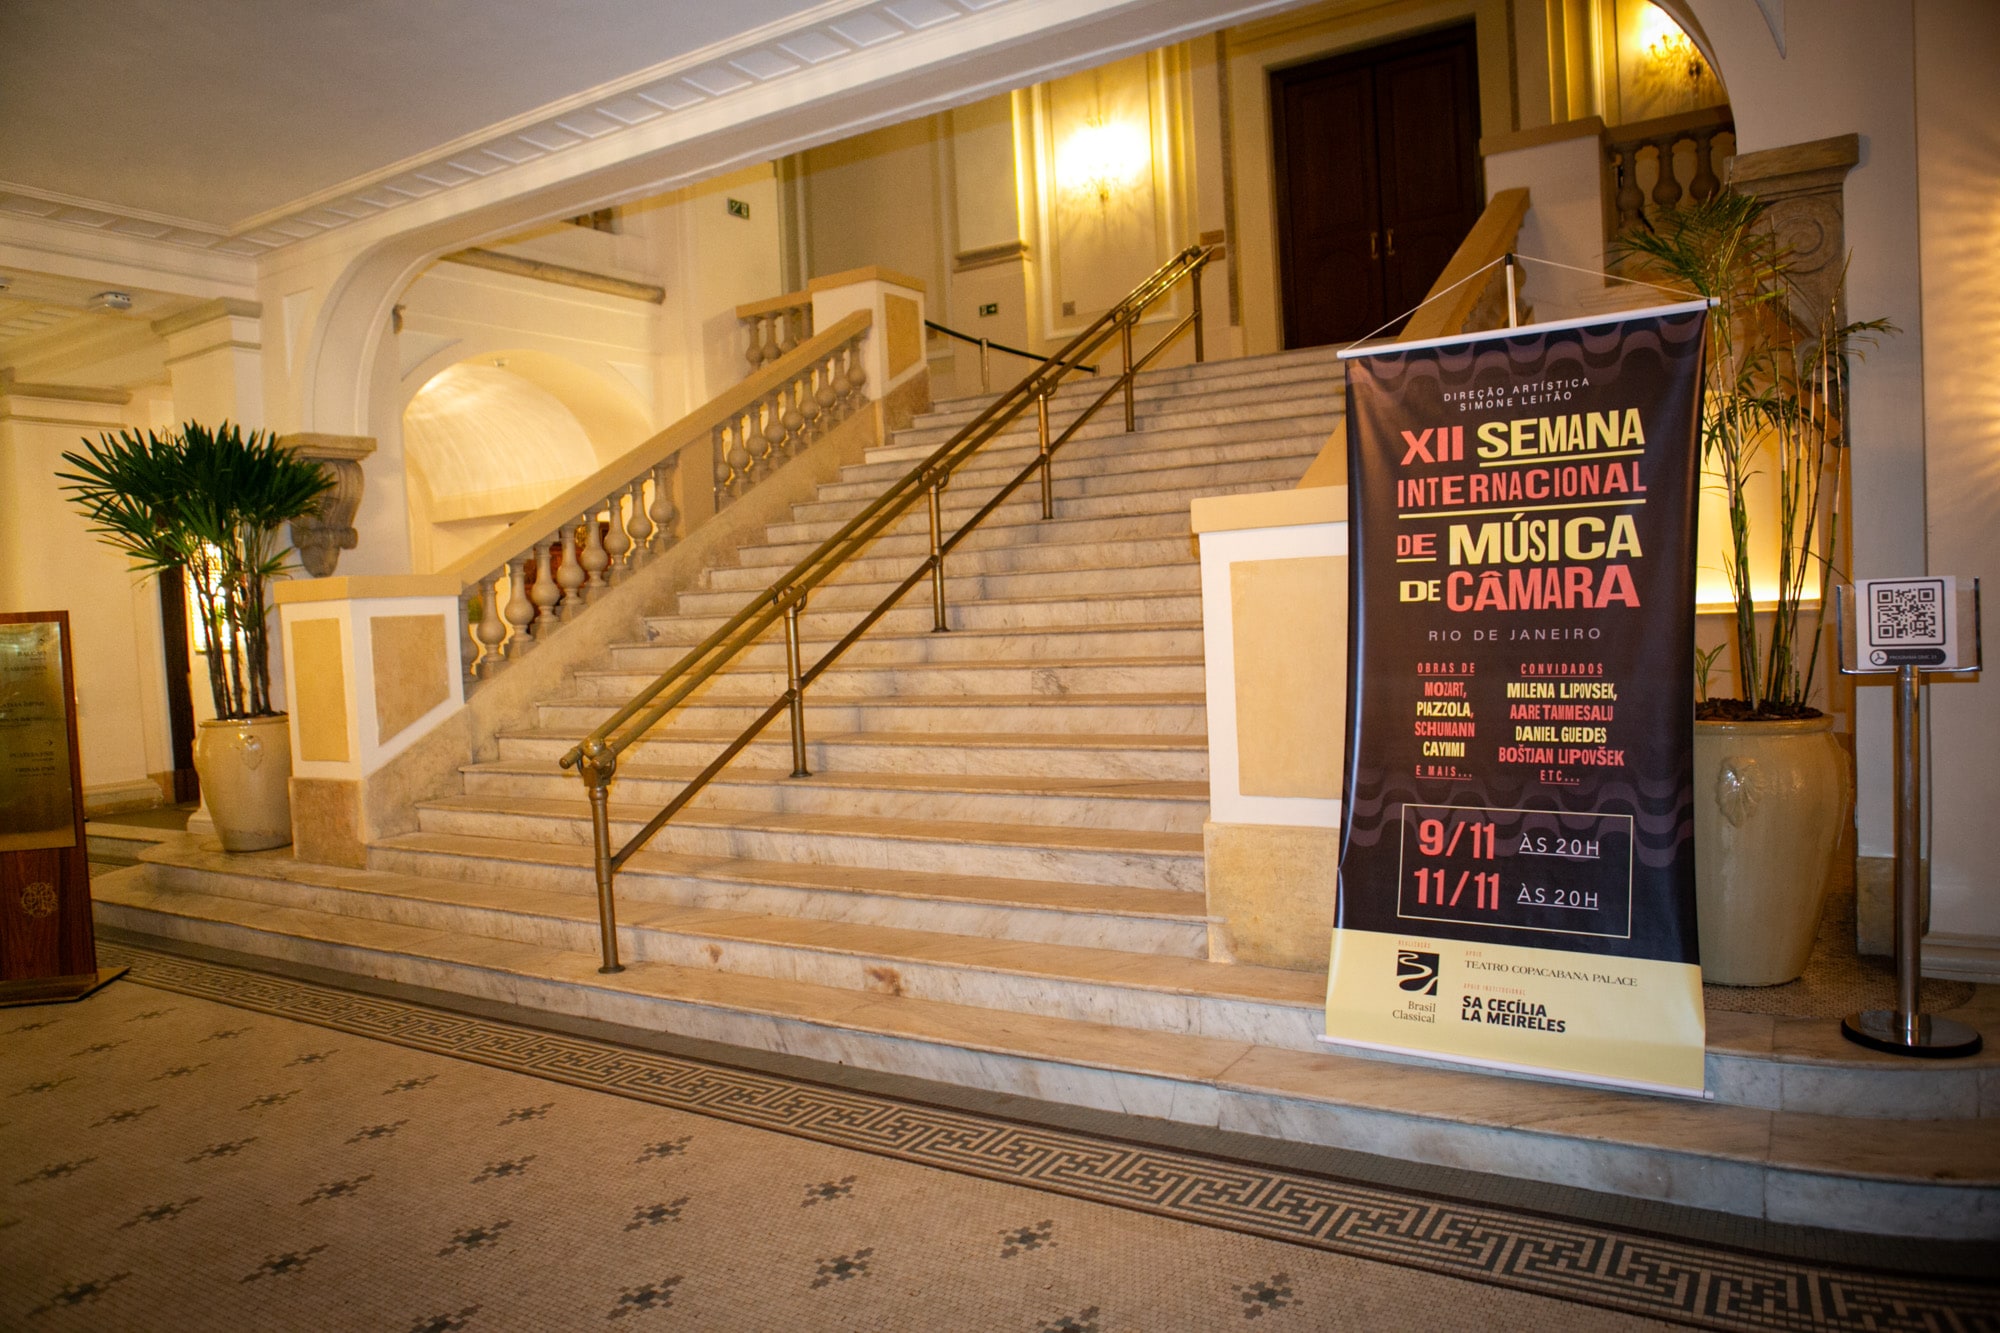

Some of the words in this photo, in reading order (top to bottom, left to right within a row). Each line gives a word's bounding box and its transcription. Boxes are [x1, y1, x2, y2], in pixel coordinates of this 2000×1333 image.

[1443, 386, 1505, 402] DIREÇÃO
[1512, 377, 1590, 395] ARTÍSTICA
[1459, 397, 1513, 412] SIMONE
[1521, 391, 1572, 406] LEITÃO
[1400, 425, 1464, 466] XII
[1476, 408, 1646, 459] SEMANA
[1397, 461, 1647, 508] INTERNACIONAL
[1397, 533, 1437, 557] DE
[1449, 513, 1643, 566] MÚSICA
[1400, 580, 1441, 602] DE
[1446, 564, 1641, 612] CÂMARA
[1428, 630, 1462, 641] RIO
[1473, 629, 1498, 641] DE
[1509, 627, 1601, 641] JANEIRO
[1417, 662, 1455, 673] OBRAS
[1461, 662, 1475, 674] DE
[1520, 663, 1603, 674] CONVIDADOS
[1424, 682, 1467, 699] MOZART,
[1507, 682, 1555, 698] MILENA
[1560, 682, 1617, 701] LIPOVSEK,
[1416, 701, 1474, 719] PIAZZOLA,
[1509, 704, 1540, 720] AARE
[1414, 721, 1475, 737] SCHUMANN
[1515, 726, 1559, 742] DANIEL
[1561, 726, 1607, 743] GUEDES
[1498, 744, 1554, 764] BOŠTJAN
[1558, 746, 1625, 766] LIPOVŠEK
[1415, 765, 1421, 776] E
[1419, 818, 1495, 860] 9/11
[1519, 833, 1547, 853] ÀS
[1556, 838, 1600, 856] 20H
[1414, 867, 1500, 910] 11/11
[1517, 883, 1546, 903] ÀS
[1554, 888, 1599, 908] 20H
[1464, 959, 1509, 973] TEATRO
[1511, 964, 1590, 982] COPACABANA
[1592, 973, 1638, 987] PALACE
[1392, 1009, 1435, 1024] Classical
[1408, 1000, 1436, 1013] Brasil
[1462, 995, 1483, 1010] SA
[1487, 998, 1547, 1017] CECÍLIA
[1461, 1008, 1482, 1022] LA
[1486, 1011, 1566, 1033] MEIRELES
